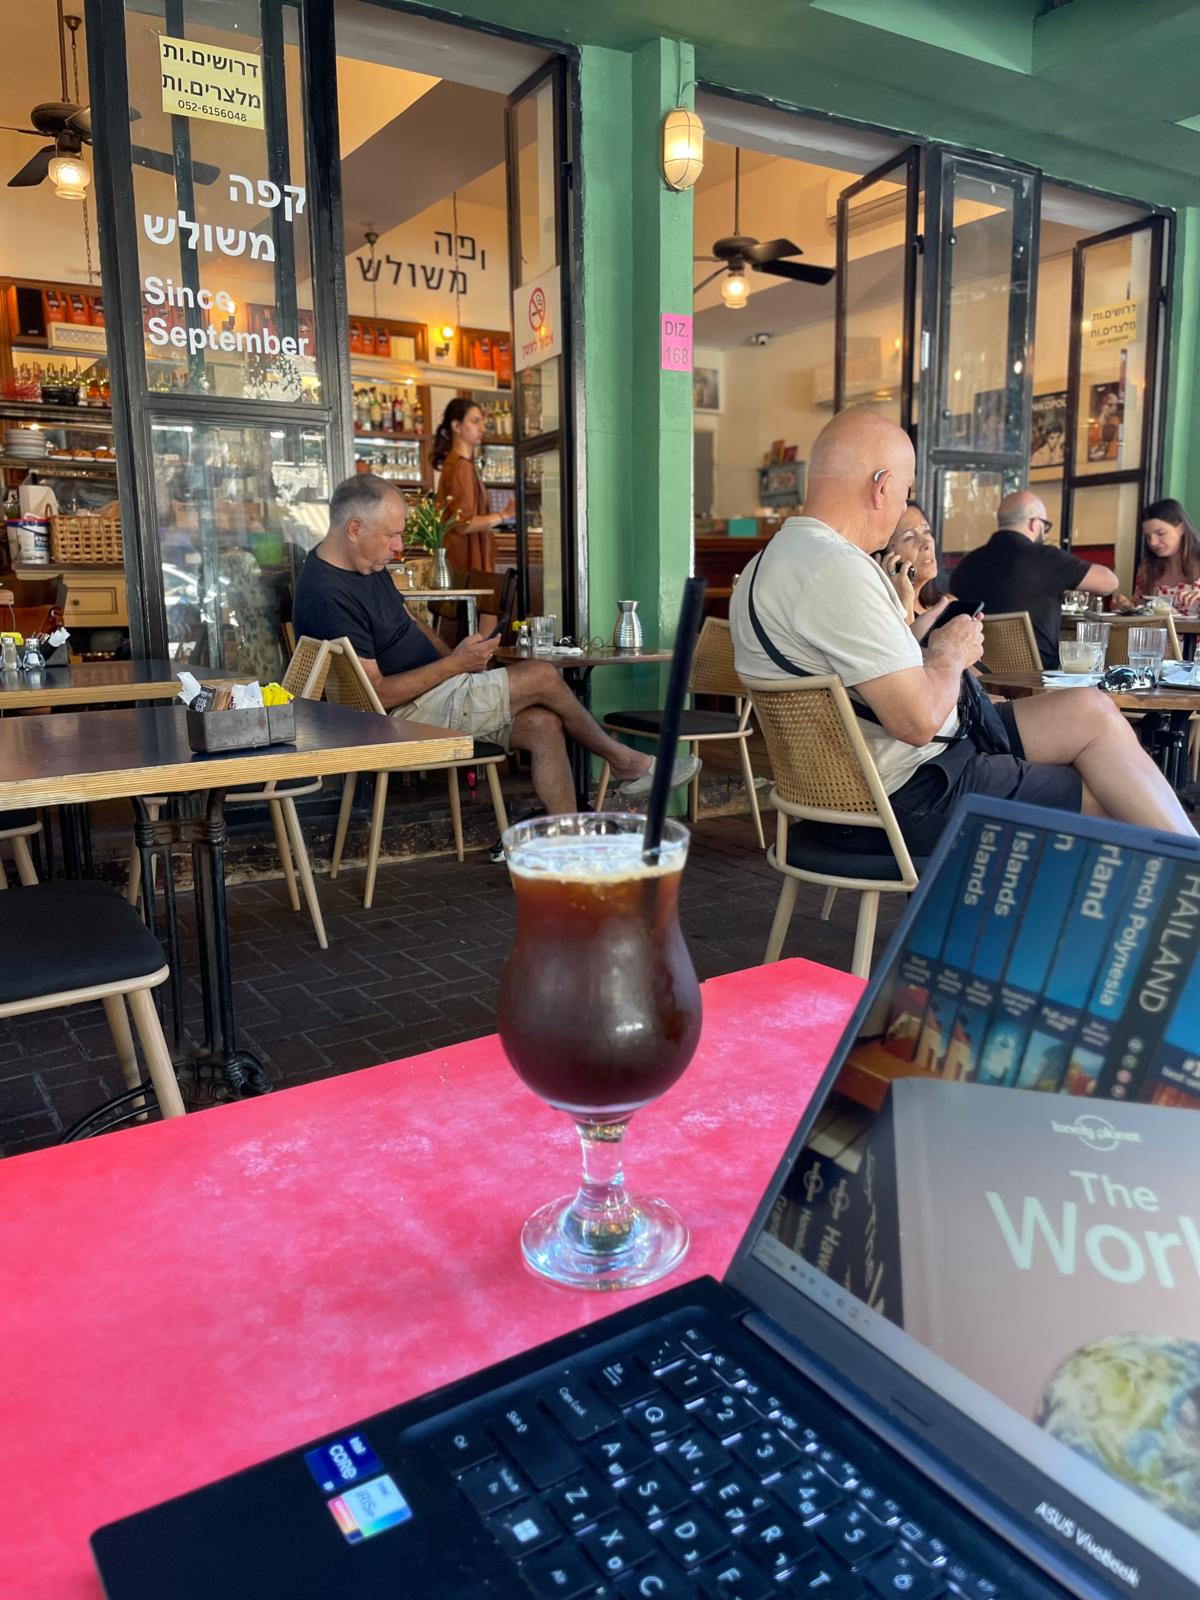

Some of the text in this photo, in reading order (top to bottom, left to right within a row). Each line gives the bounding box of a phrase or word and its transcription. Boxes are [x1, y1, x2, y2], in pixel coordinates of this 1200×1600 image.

[163, 44, 258, 78] דרושים.ות
[162, 74, 261, 109] מלצרים.ות
[178, 99, 247, 122] 052-6156048
[229, 174, 306, 222] קפה
[143, 210, 276, 262] משולש
[356, 254, 467, 295] משולש
[144, 276, 233, 312] Since
[147, 317, 309, 356] September
[665, 346, 689, 364] 168
[963, 823, 1002, 906] Islands
[994, 831, 1036, 916] Islands
[1100, 914, 1148, 1006] Polynesia
[1069, 1170, 1160, 1213] The
[645, 1406, 664, 1424] Q
[717, 1408, 735, 1422] 2
[601, 1442, 622, 1458] A
[678, 1440, 704, 1461] W
[756, 1444, 774, 1459] 3
[564, 1486, 589, 1504] Z
[637, 1480, 658, 1497] S
[718, 1482, 740, 1500] E
[799, 1487, 817, 1499] 4
[1033, 1501, 1076, 1538] ASUS
[600, 1528, 624, 1547] X
[674, 1521, 697, 1539] D
[760, 1525, 783, 1543] R
[844, 1528, 866, 1543] 5
[717, 1567, 742, 1583] F
[808, 1570, 831, 1588] T
[893, 1573, 913, 1590] 6
[639, 1574, 665, 1598] C
